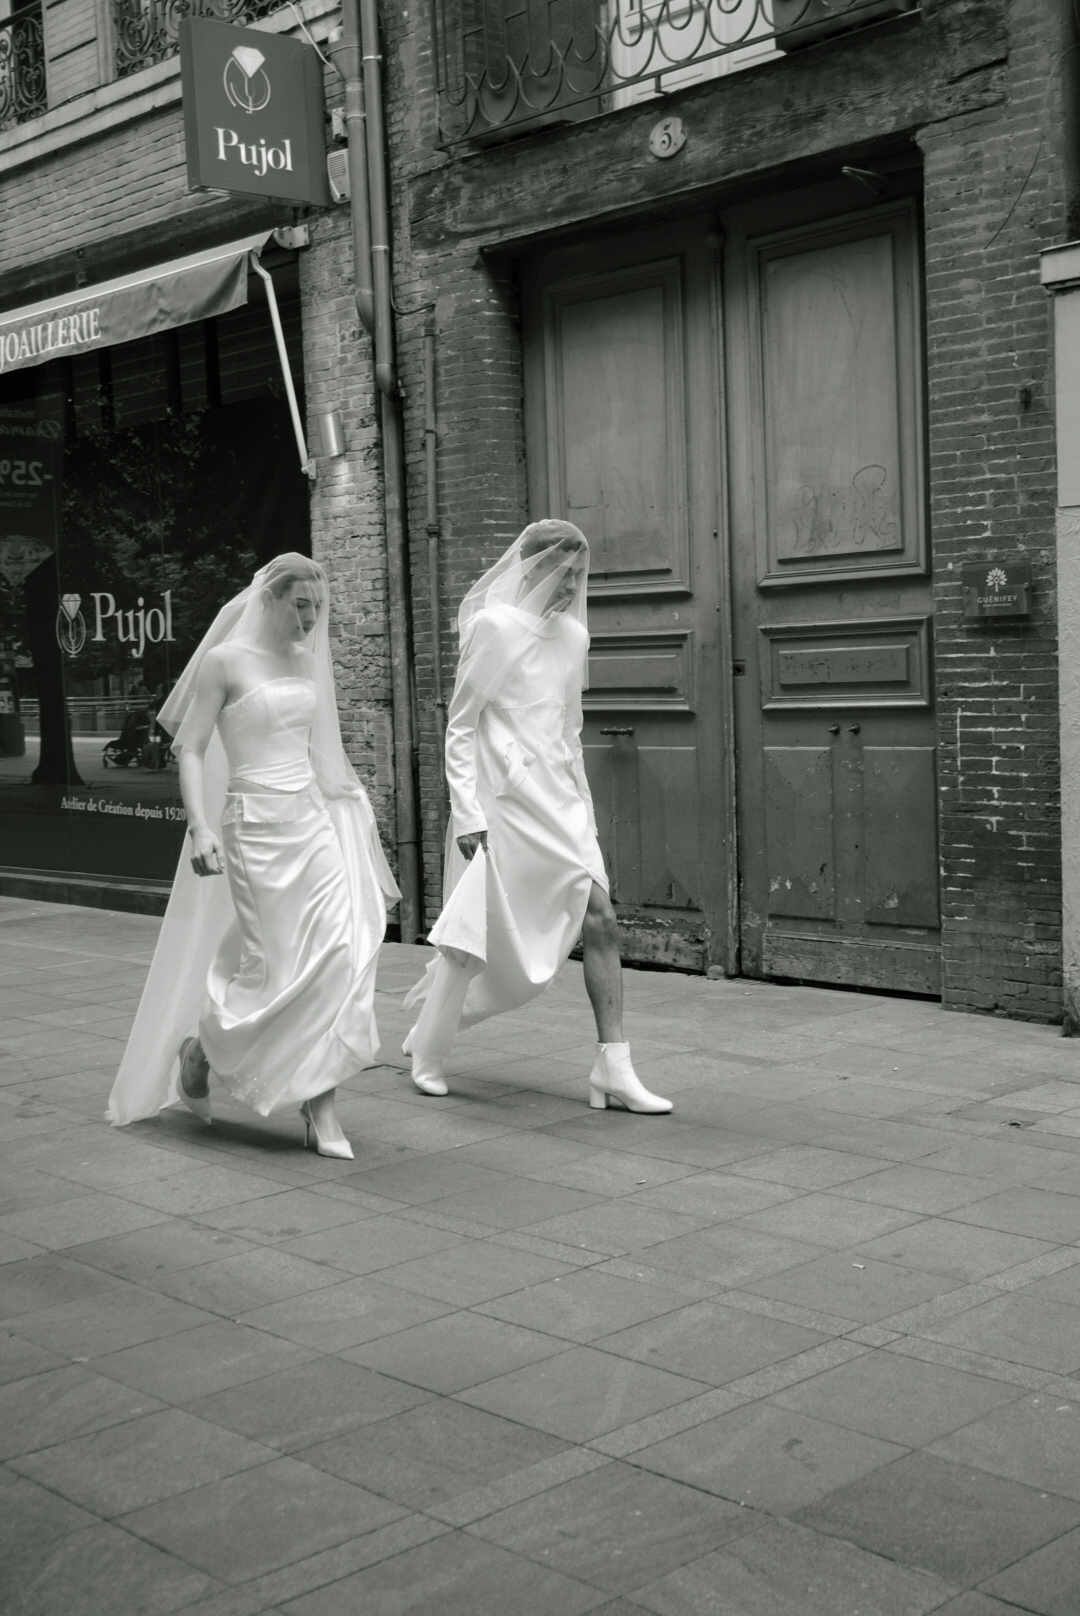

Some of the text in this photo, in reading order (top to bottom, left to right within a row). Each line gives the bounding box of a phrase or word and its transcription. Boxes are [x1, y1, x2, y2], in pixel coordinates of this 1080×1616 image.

[213, 127, 293, 177] Pujol
[660, 122, 672, 151] 5
[0, 308, 102, 372] JOAILLERIE
[976, 595, 1018, 604] GUÉNIFEY
[90, 589, 177, 658] Pujol
[60, 796, 187, 822] Atelier de Création depuis 1920
